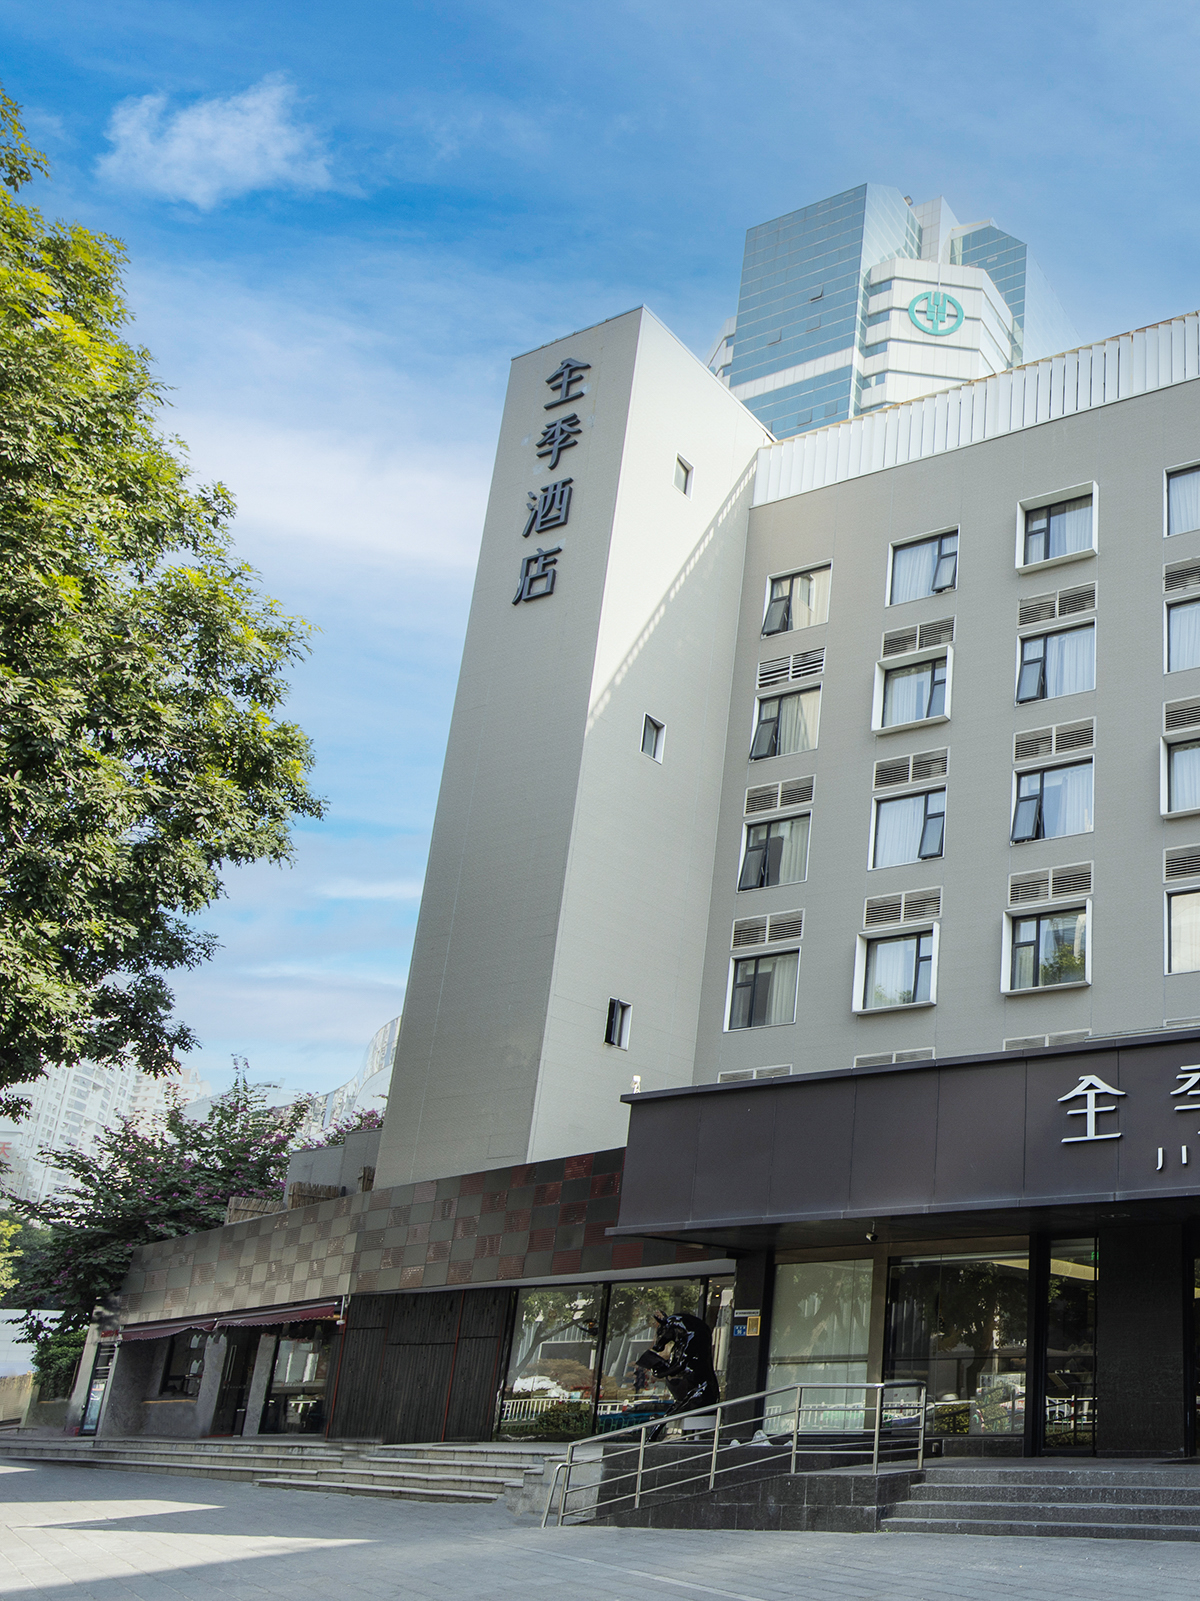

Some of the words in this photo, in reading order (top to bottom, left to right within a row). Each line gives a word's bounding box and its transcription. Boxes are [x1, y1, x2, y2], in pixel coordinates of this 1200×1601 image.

[512, 357, 591, 606] 全季酒店
[1156, 1145, 1189, 1170] JI
